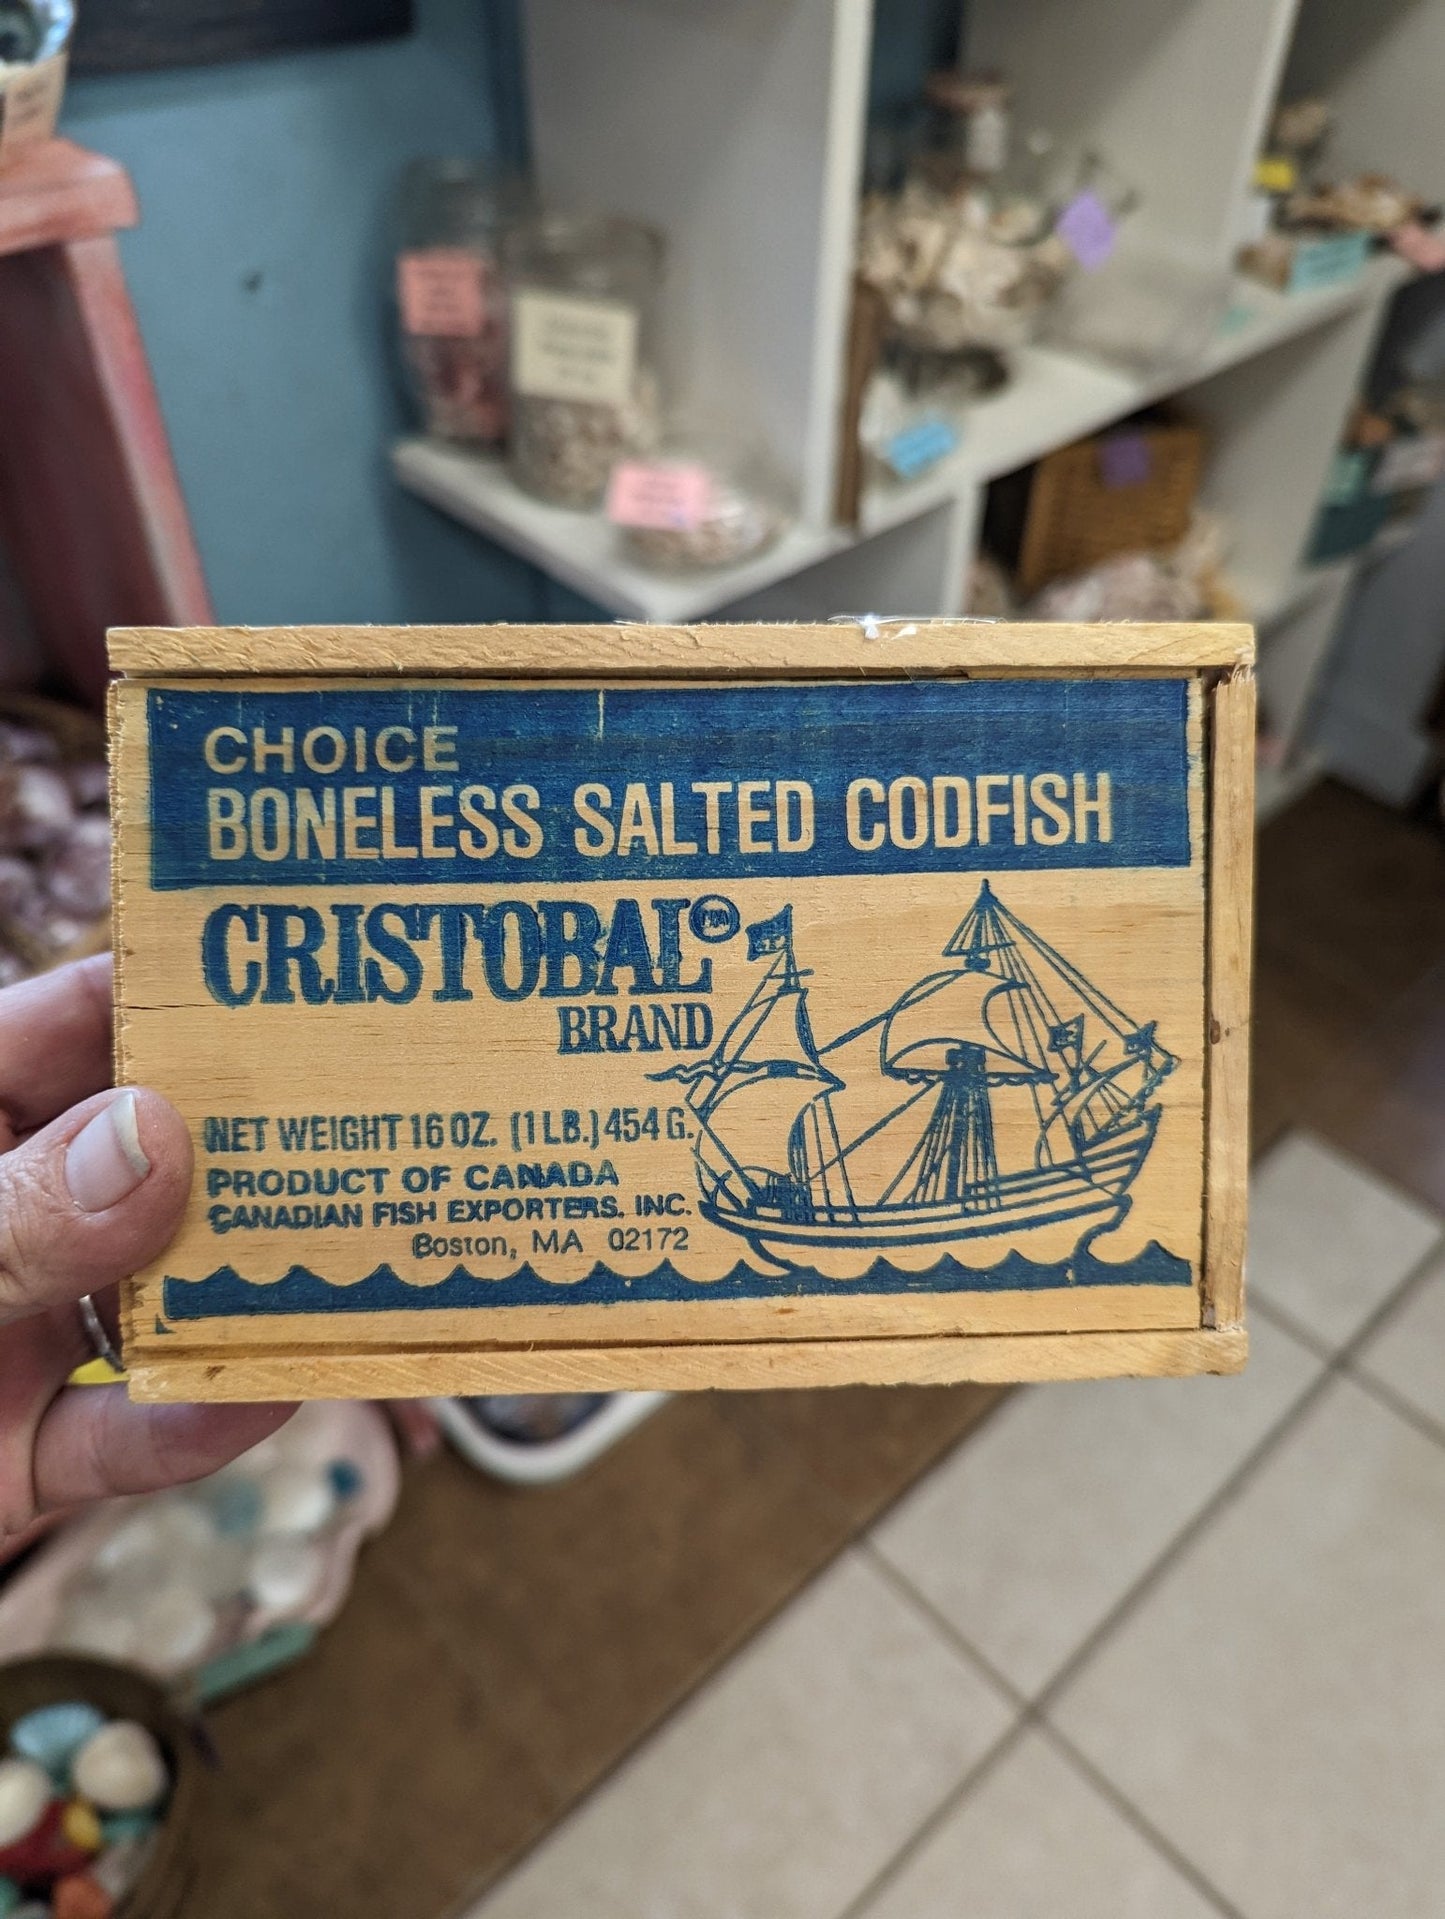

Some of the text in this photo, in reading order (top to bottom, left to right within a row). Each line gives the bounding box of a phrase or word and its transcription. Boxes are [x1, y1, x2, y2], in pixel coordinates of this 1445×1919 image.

[204, 725, 460, 775] CHOICE
[208, 772, 1112, 862] BONELESS SALTED CODFISH
[201, 898, 713, 1008] CRISTOBAL
[557, 1001, 714, 1054] BRAND
[205, 1116, 269, 1151] NET
[277, 1113, 403, 1151] WEIGHT
[207, 1159, 620, 1198] PRODUCT OF CANADA
[208, 1202, 364, 1234] CANADIAN
[372, 1200, 437, 1227] FISH
[635, 1192, 692, 1217] INC.
[412, 1226, 690, 1260] Boston, MA 02172
